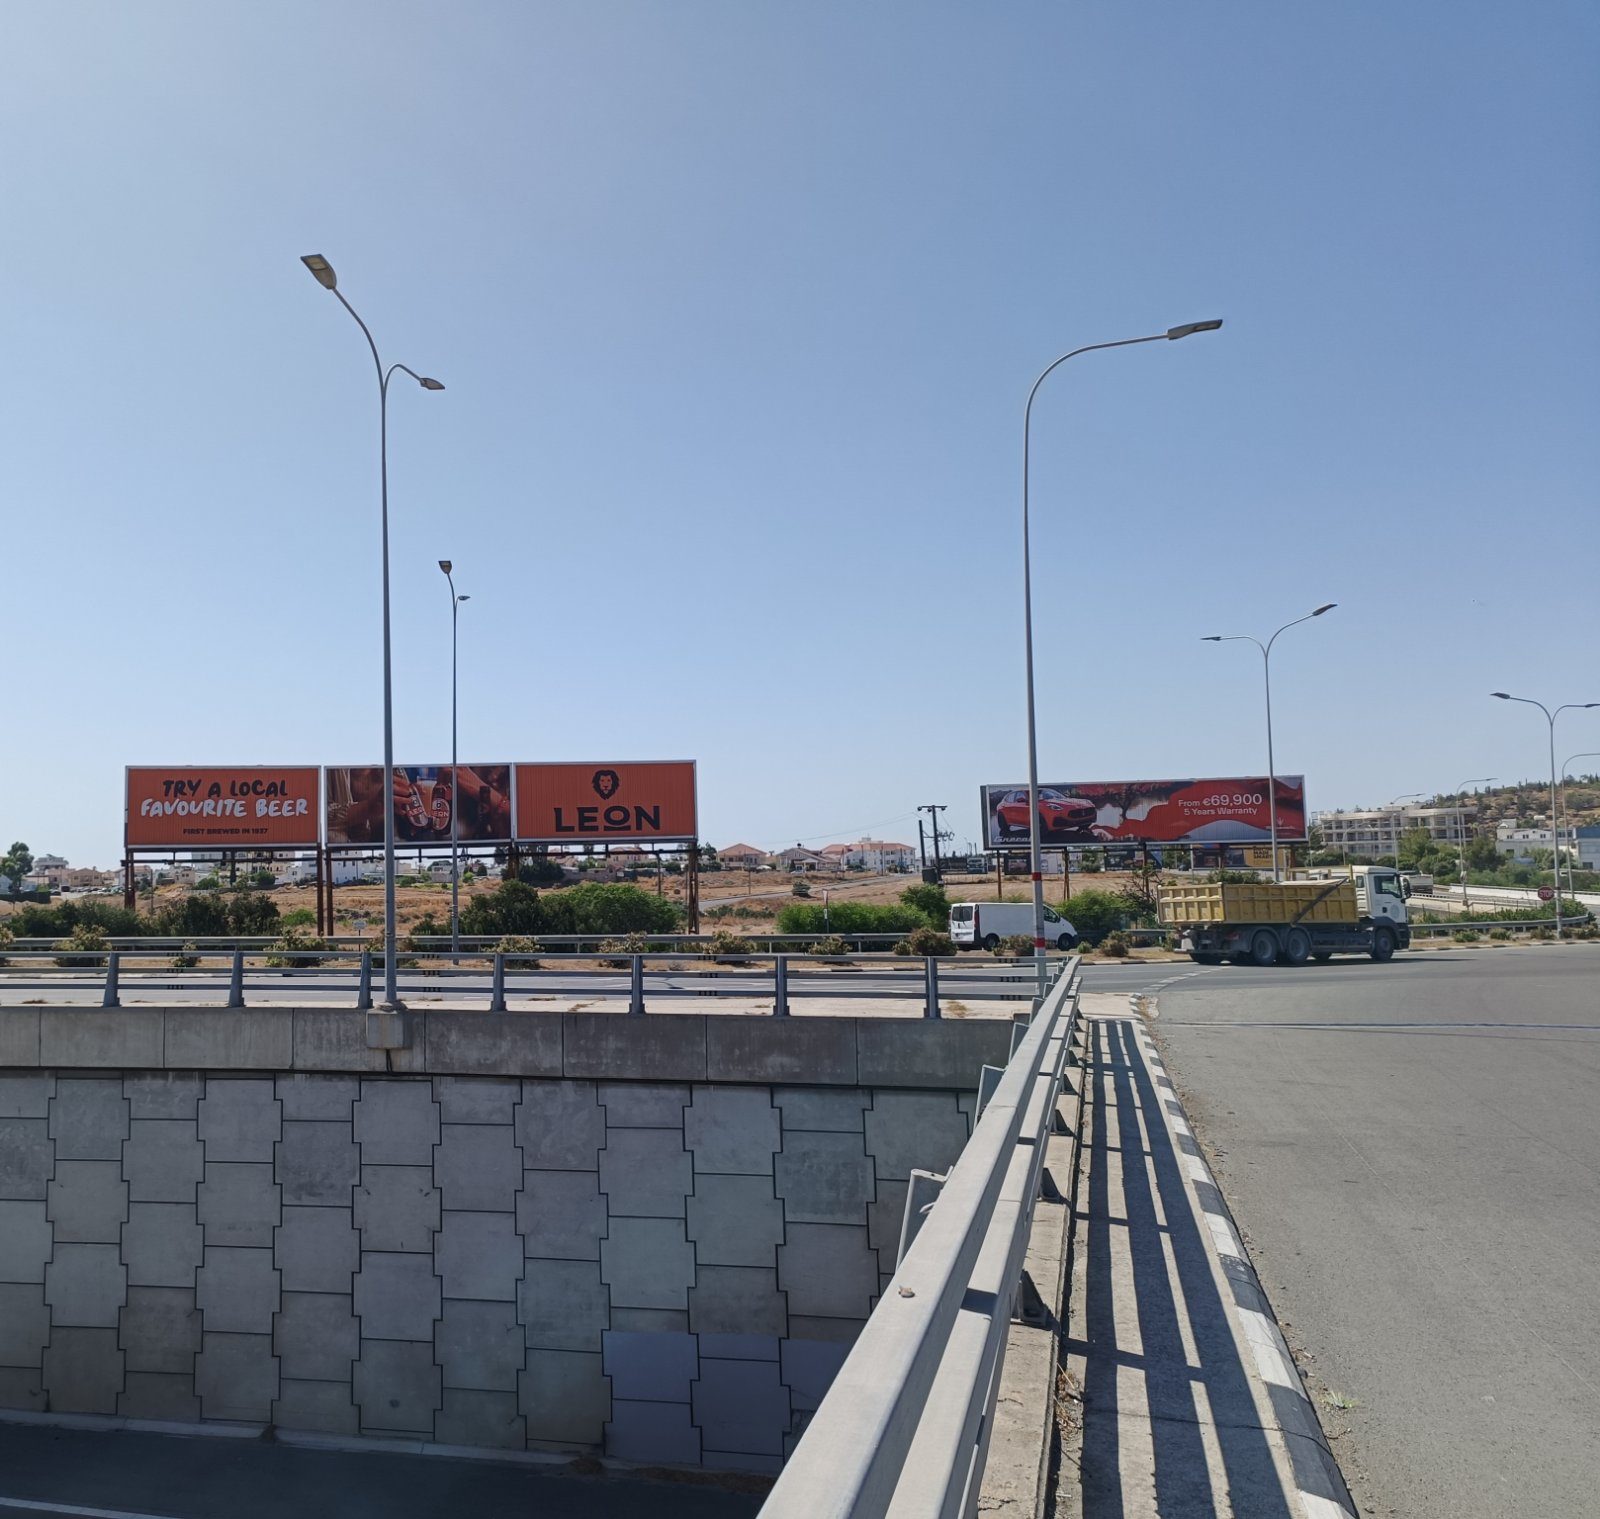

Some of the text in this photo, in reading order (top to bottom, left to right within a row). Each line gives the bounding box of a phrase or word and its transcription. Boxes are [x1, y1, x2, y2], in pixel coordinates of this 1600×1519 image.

[163, 779, 288, 798] TRY A LOCAL
[141, 798, 308, 817] FAVOURITE BEER
[1178, 799, 1200, 807] From
[554, 805, 660, 832] LEON
[1184, 808, 1190, 816] 5
[1217, 807, 1258, 815] Warranty
[1539, 890, 1553, 898] STOP
